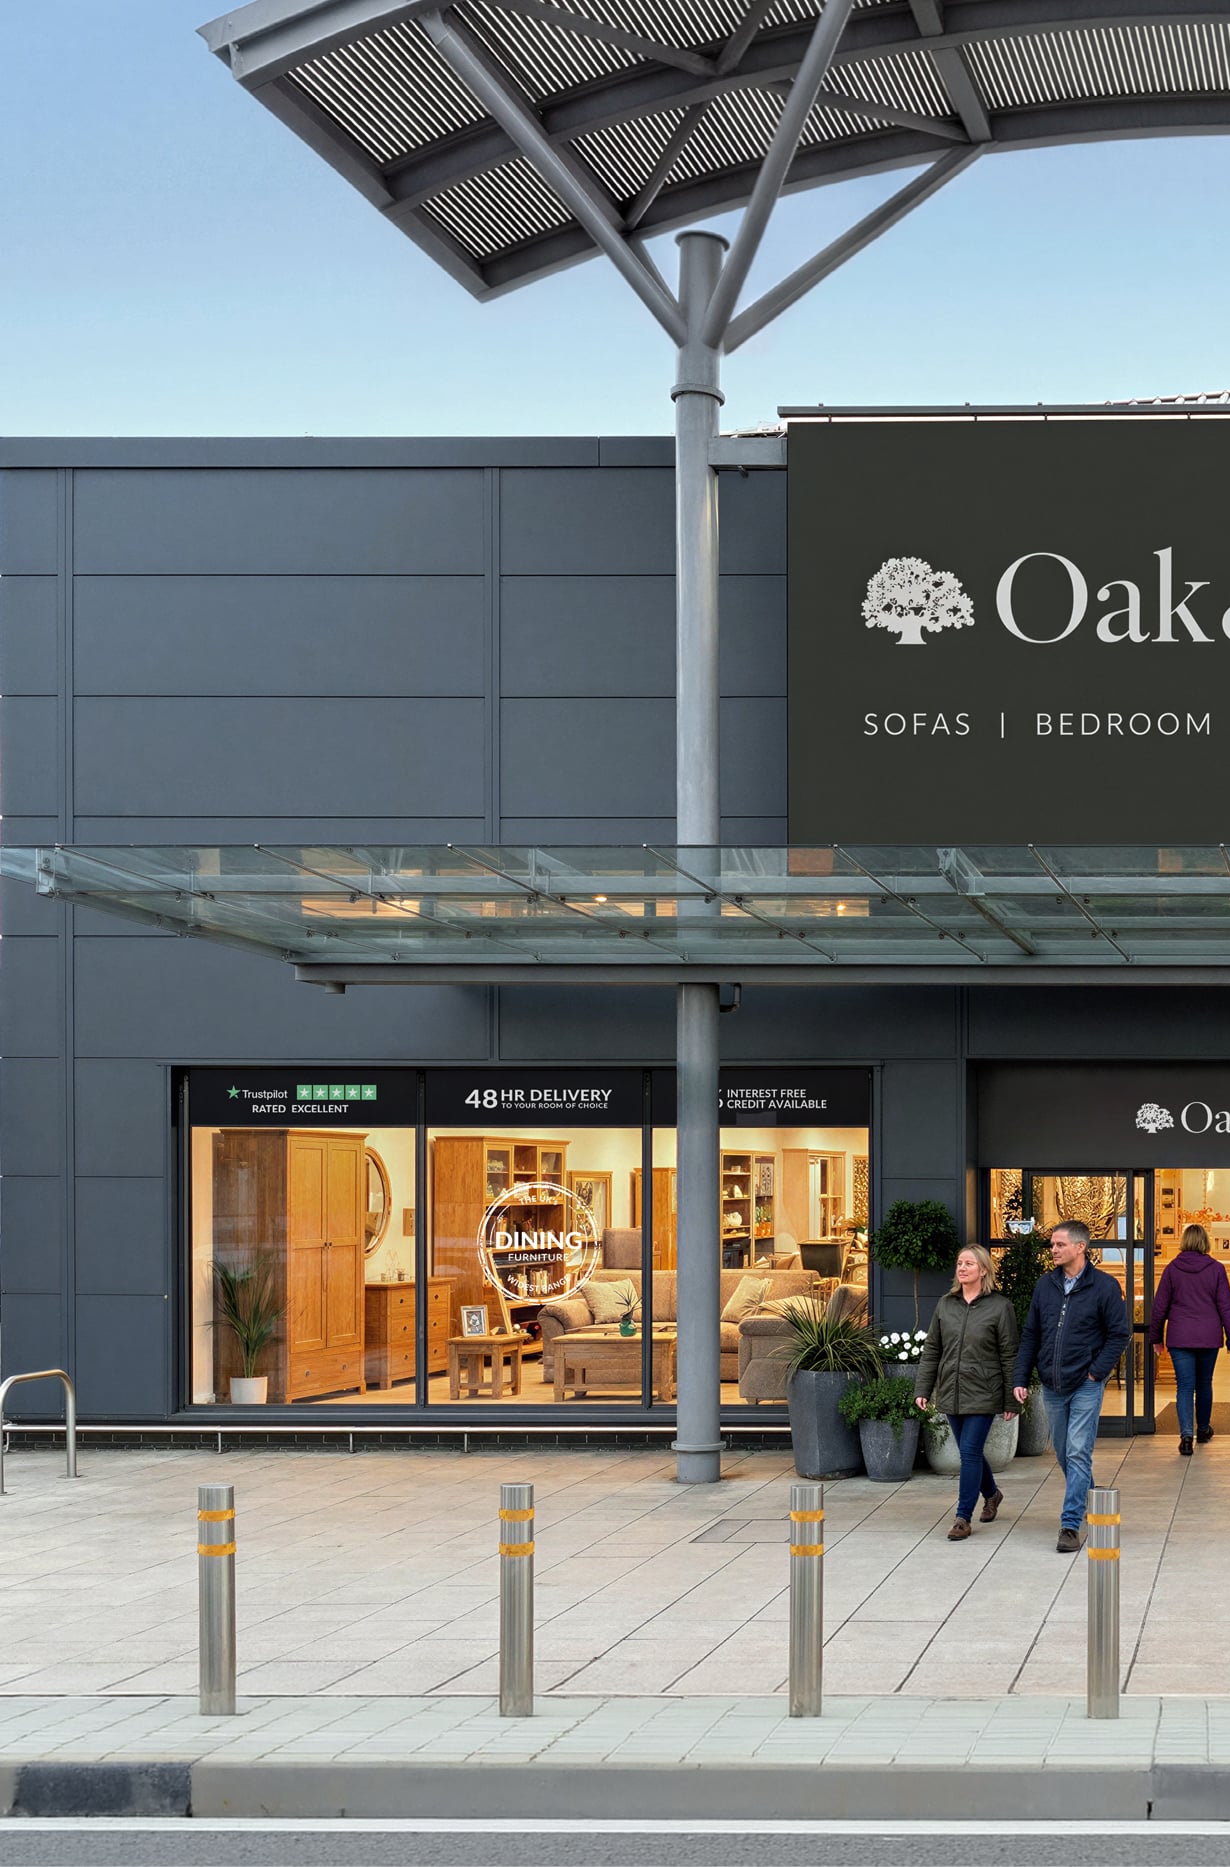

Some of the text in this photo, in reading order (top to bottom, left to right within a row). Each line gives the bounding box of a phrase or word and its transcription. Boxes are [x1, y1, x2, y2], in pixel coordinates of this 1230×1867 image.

[863, 712, 970, 736] SOFAS
[1036, 712, 1210, 736] BEDROOM
[242, 1089, 288, 1100] Trustpilot
[464, 1089, 613, 1109] 48 HR DELIVERY
[727, 1089, 807, 1098] INTEREST FREE
[252, 1104, 349, 1113] RATED EXCELLENT
[727, 1099, 827, 1109] CREDIT AVAILABLE
[495, 1231, 583, 1250] DINING
[508, 1253, 570, 1262] FURNITURE
[507, 1274, 571, 1292] WIDEST RANGE
